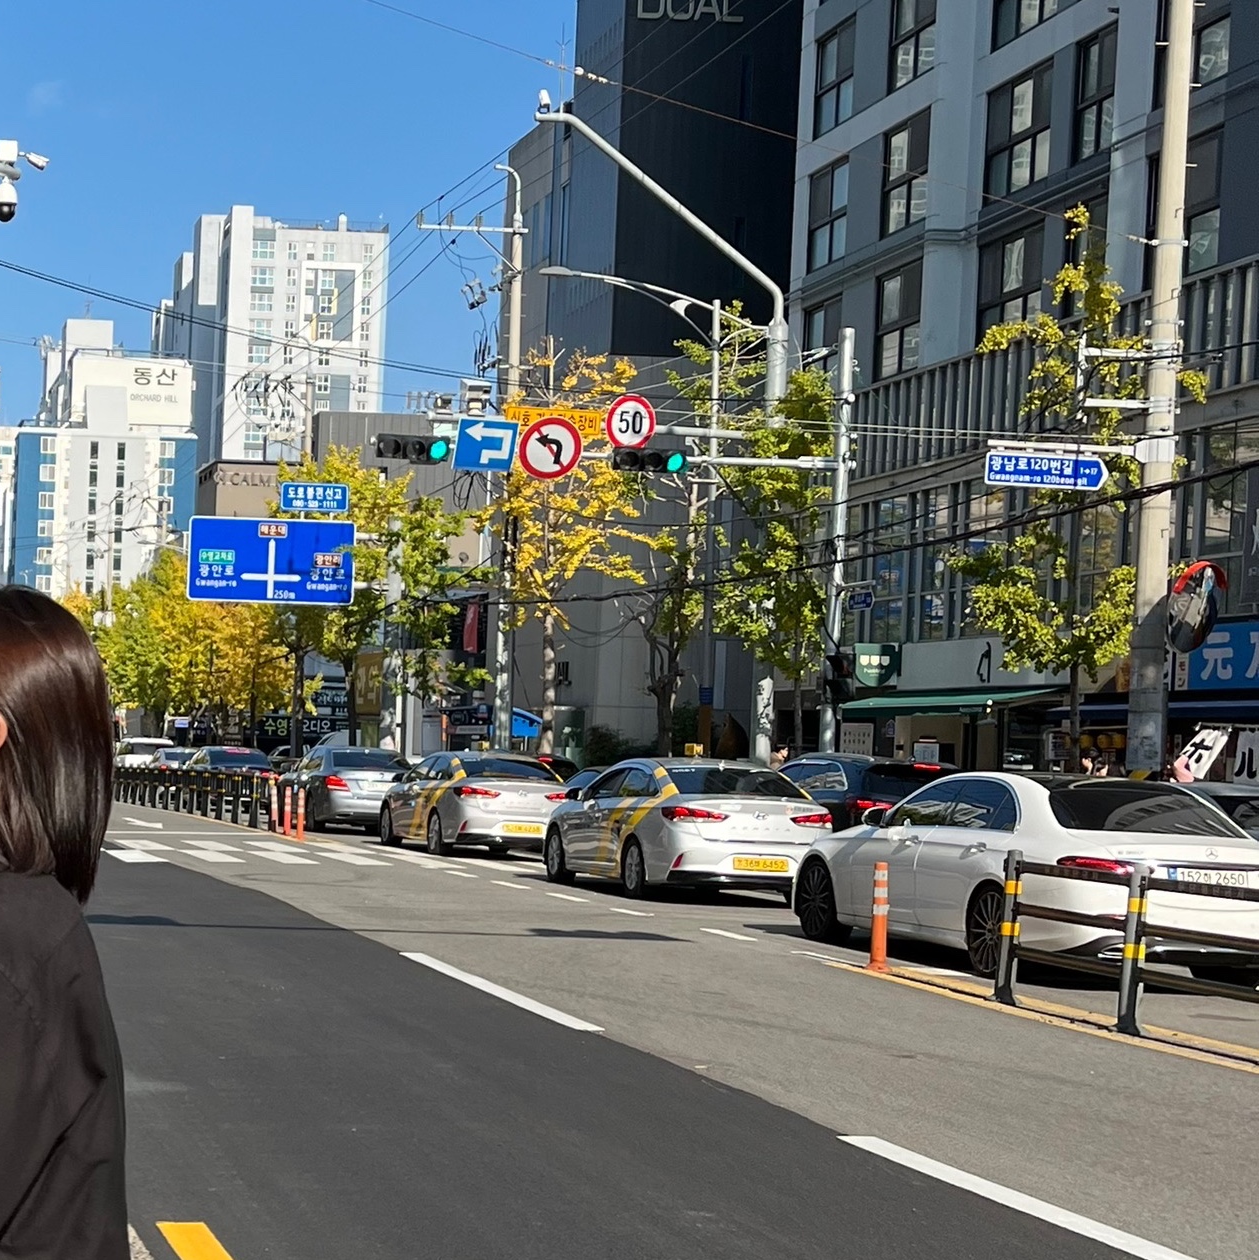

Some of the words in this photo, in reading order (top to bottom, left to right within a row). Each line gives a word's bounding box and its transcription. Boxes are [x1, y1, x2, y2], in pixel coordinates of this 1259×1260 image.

[133, 367, 178, 386] 동산
[130, 393, 162, 403] ORCHARD
[164, 394, 178, 403] HILL
[618, 410, 643, 434] 50
[198, 565, 235, 578] 광안로
[195, 577, 238, 589] Gwangan-ro
[274, 589, 296, 600] 250m
[264, 719, 288, 736] 수영
[1215, 872, 1245, 886] 2650
